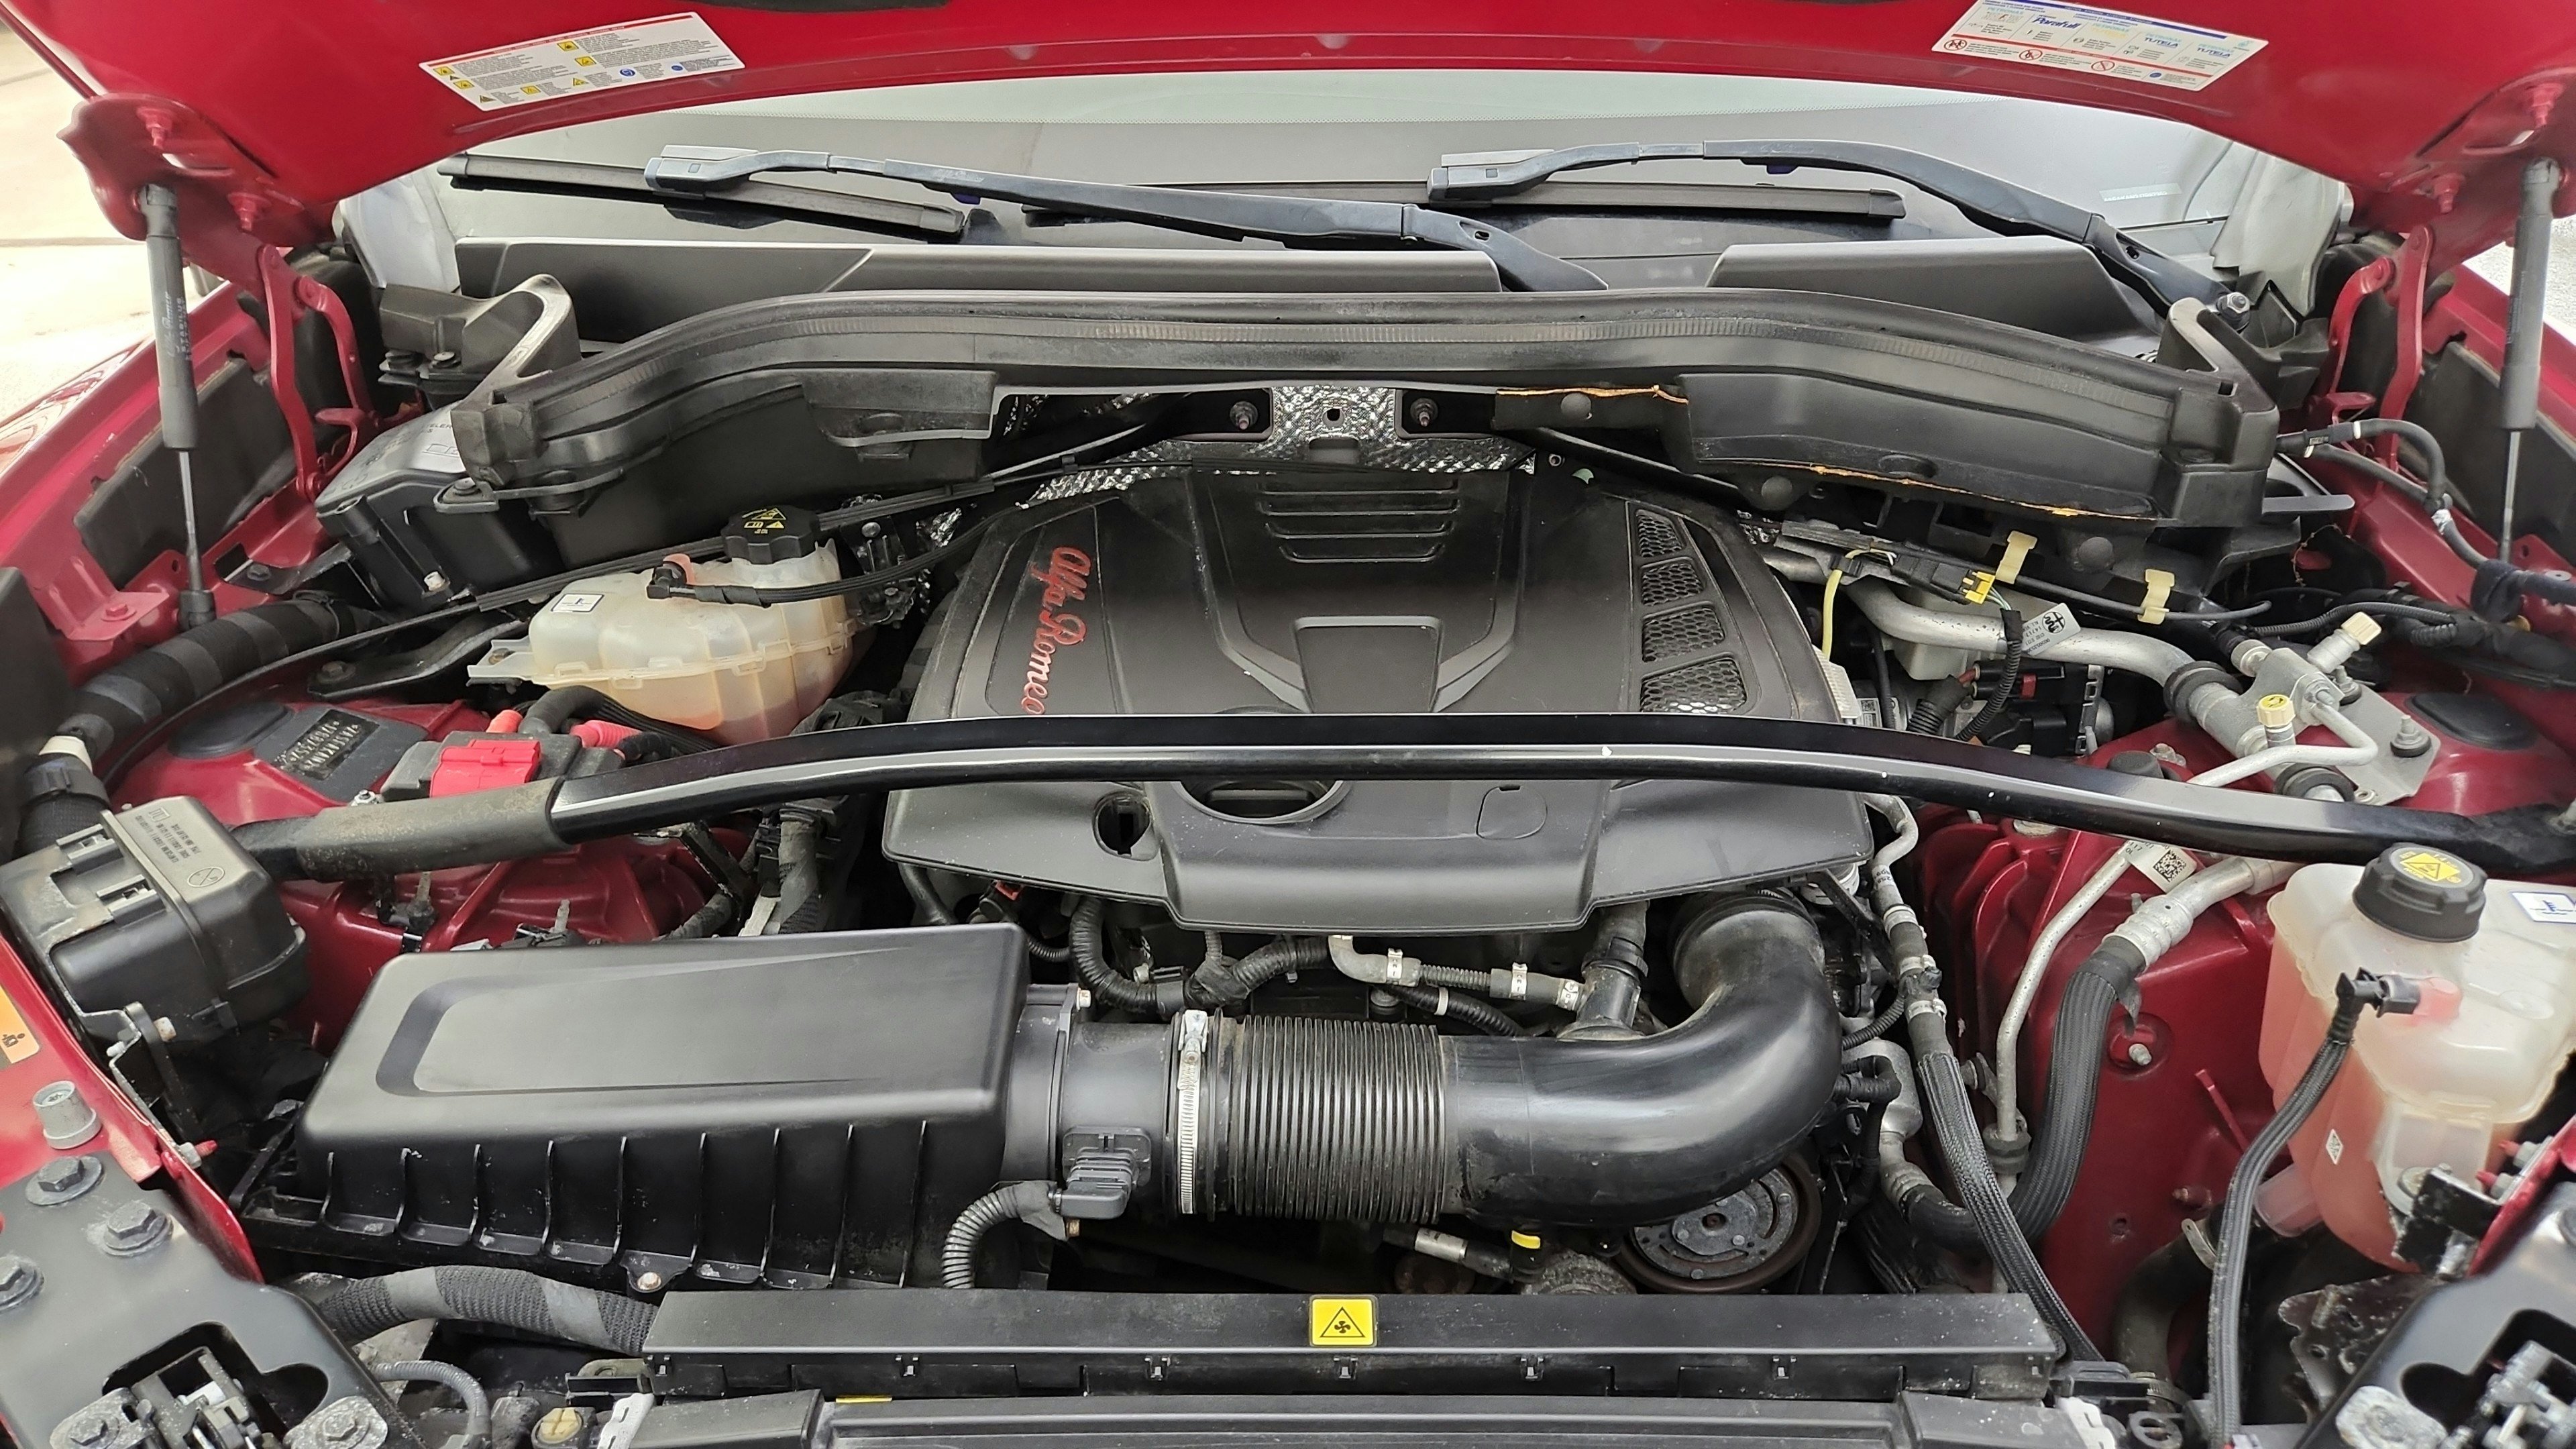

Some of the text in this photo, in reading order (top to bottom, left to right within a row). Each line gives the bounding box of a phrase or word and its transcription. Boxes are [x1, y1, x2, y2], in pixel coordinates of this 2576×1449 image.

[2144, 37, 2179, 48] TUTELA
[2196, 47, 2231, 58] TUTELA
[176, 298, 186, 352] STABILUS
[1020, 545, 1091, 715] Alfa Romeo
